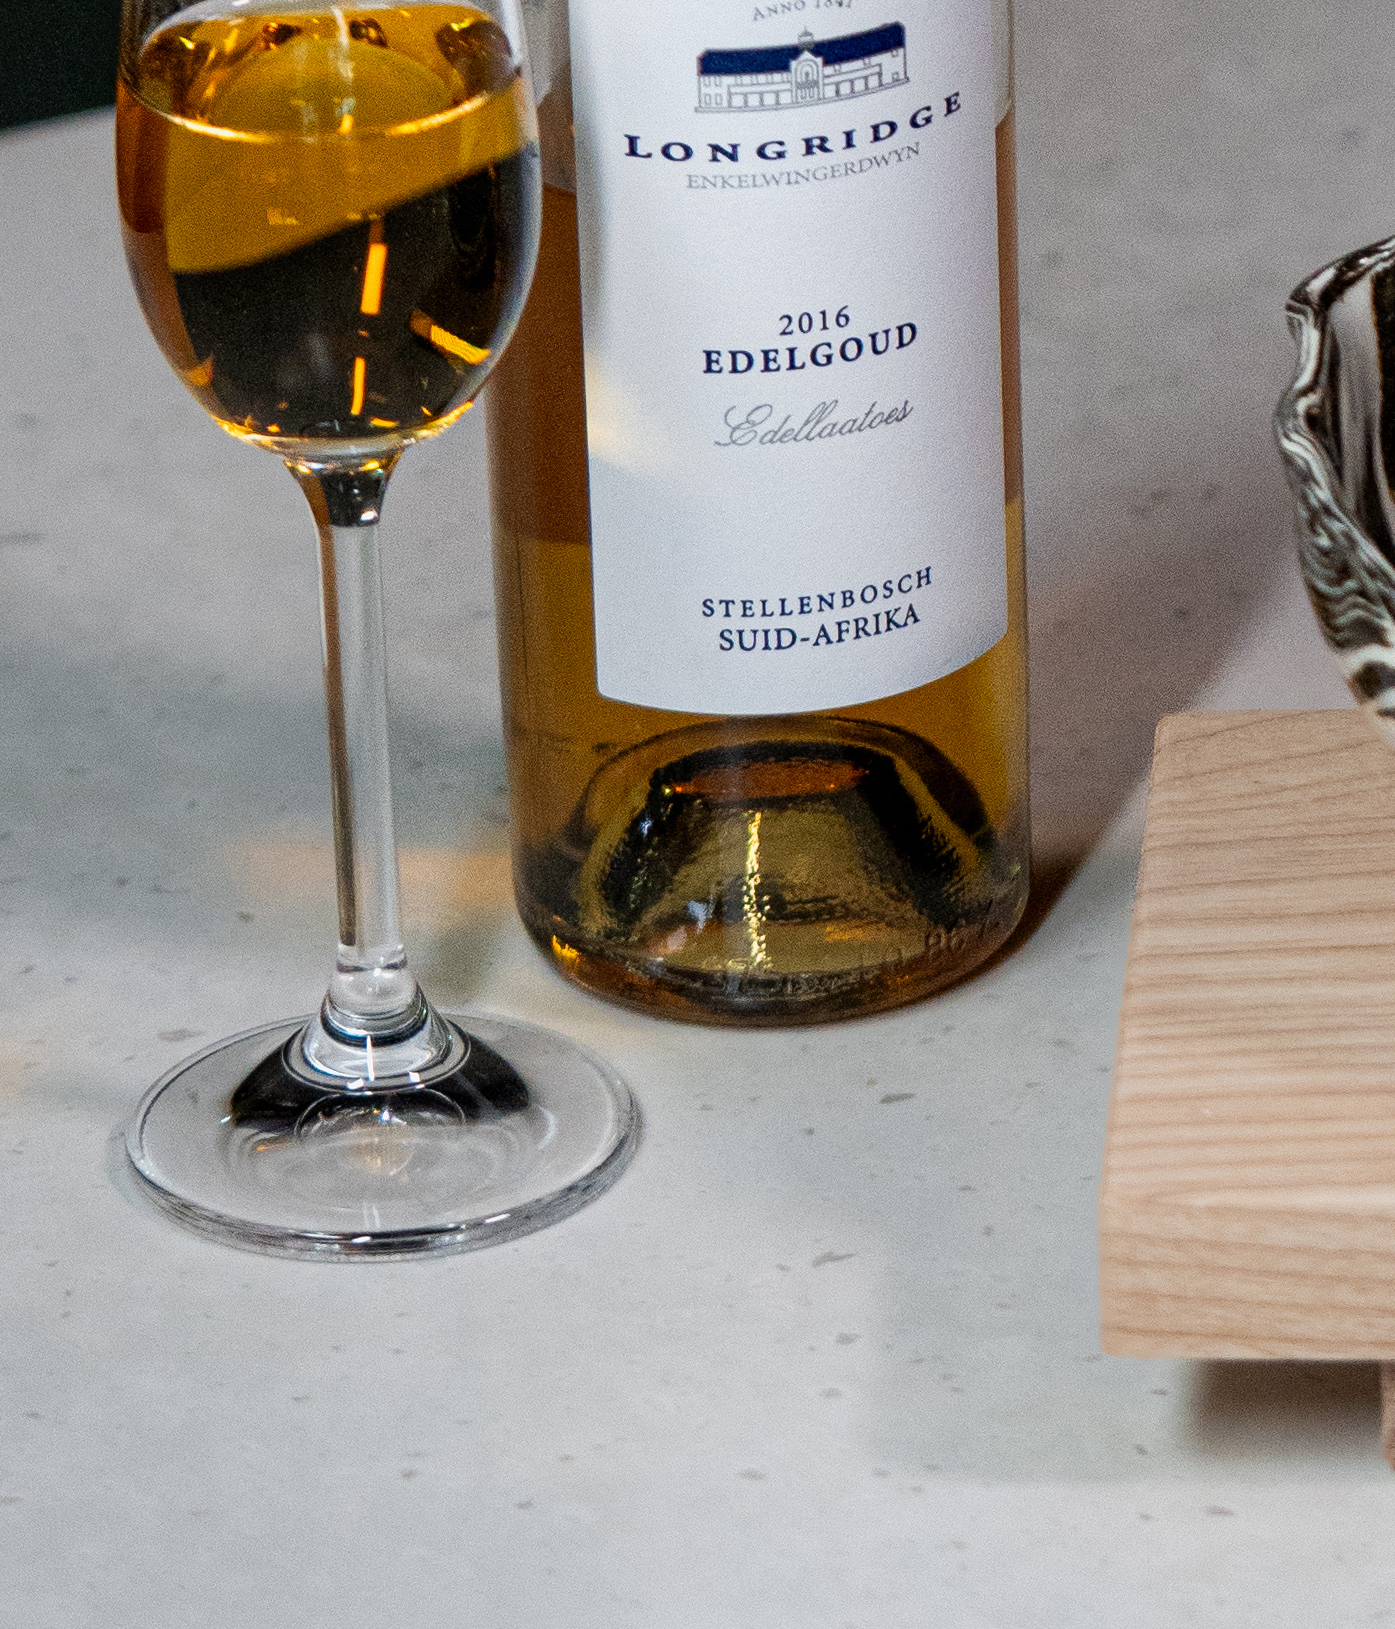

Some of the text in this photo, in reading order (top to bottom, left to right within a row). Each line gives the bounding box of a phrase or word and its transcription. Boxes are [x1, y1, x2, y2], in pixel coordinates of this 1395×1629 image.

[623, 91, 963, 163] LONGRIDGE
[685, 141, 922, 191] ENKELWINGERDWYN
[778, 304, 852, 337] 2016
[702, 321, 919, 375] EDELGOUD
[714, 399, 915, 448] Edellaatoes
[701, 565, 933, 619] STELLENBOSCH
[718, 602, 921, 653] SUID-AFRIKA
